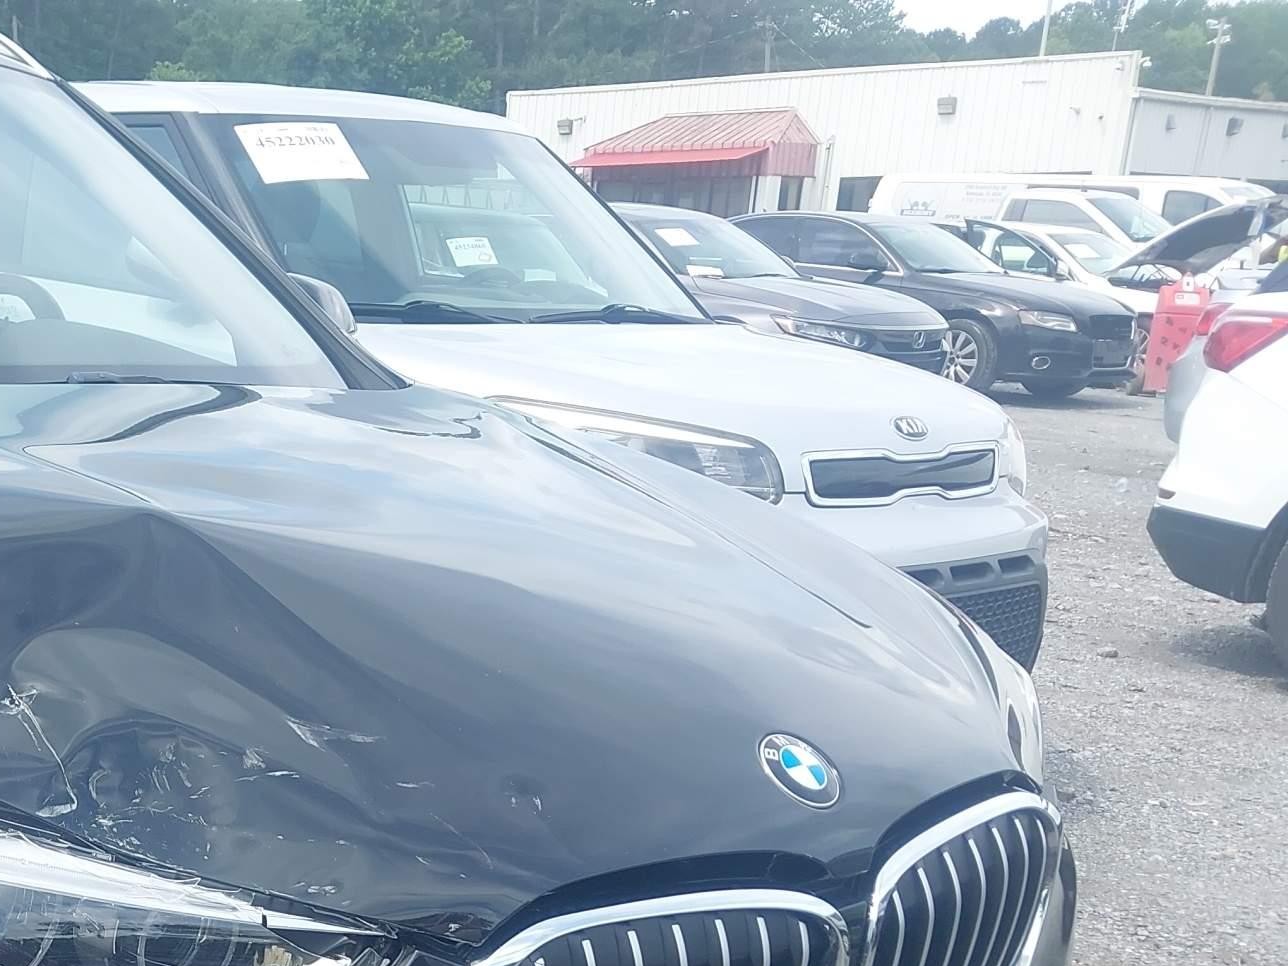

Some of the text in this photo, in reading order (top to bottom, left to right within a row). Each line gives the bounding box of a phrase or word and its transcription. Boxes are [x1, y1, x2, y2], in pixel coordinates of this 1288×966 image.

[256, 136, 335, 147] 45222030
[895, 417, 927, 433] KIA
[764, 735, 811, 761] BMW
